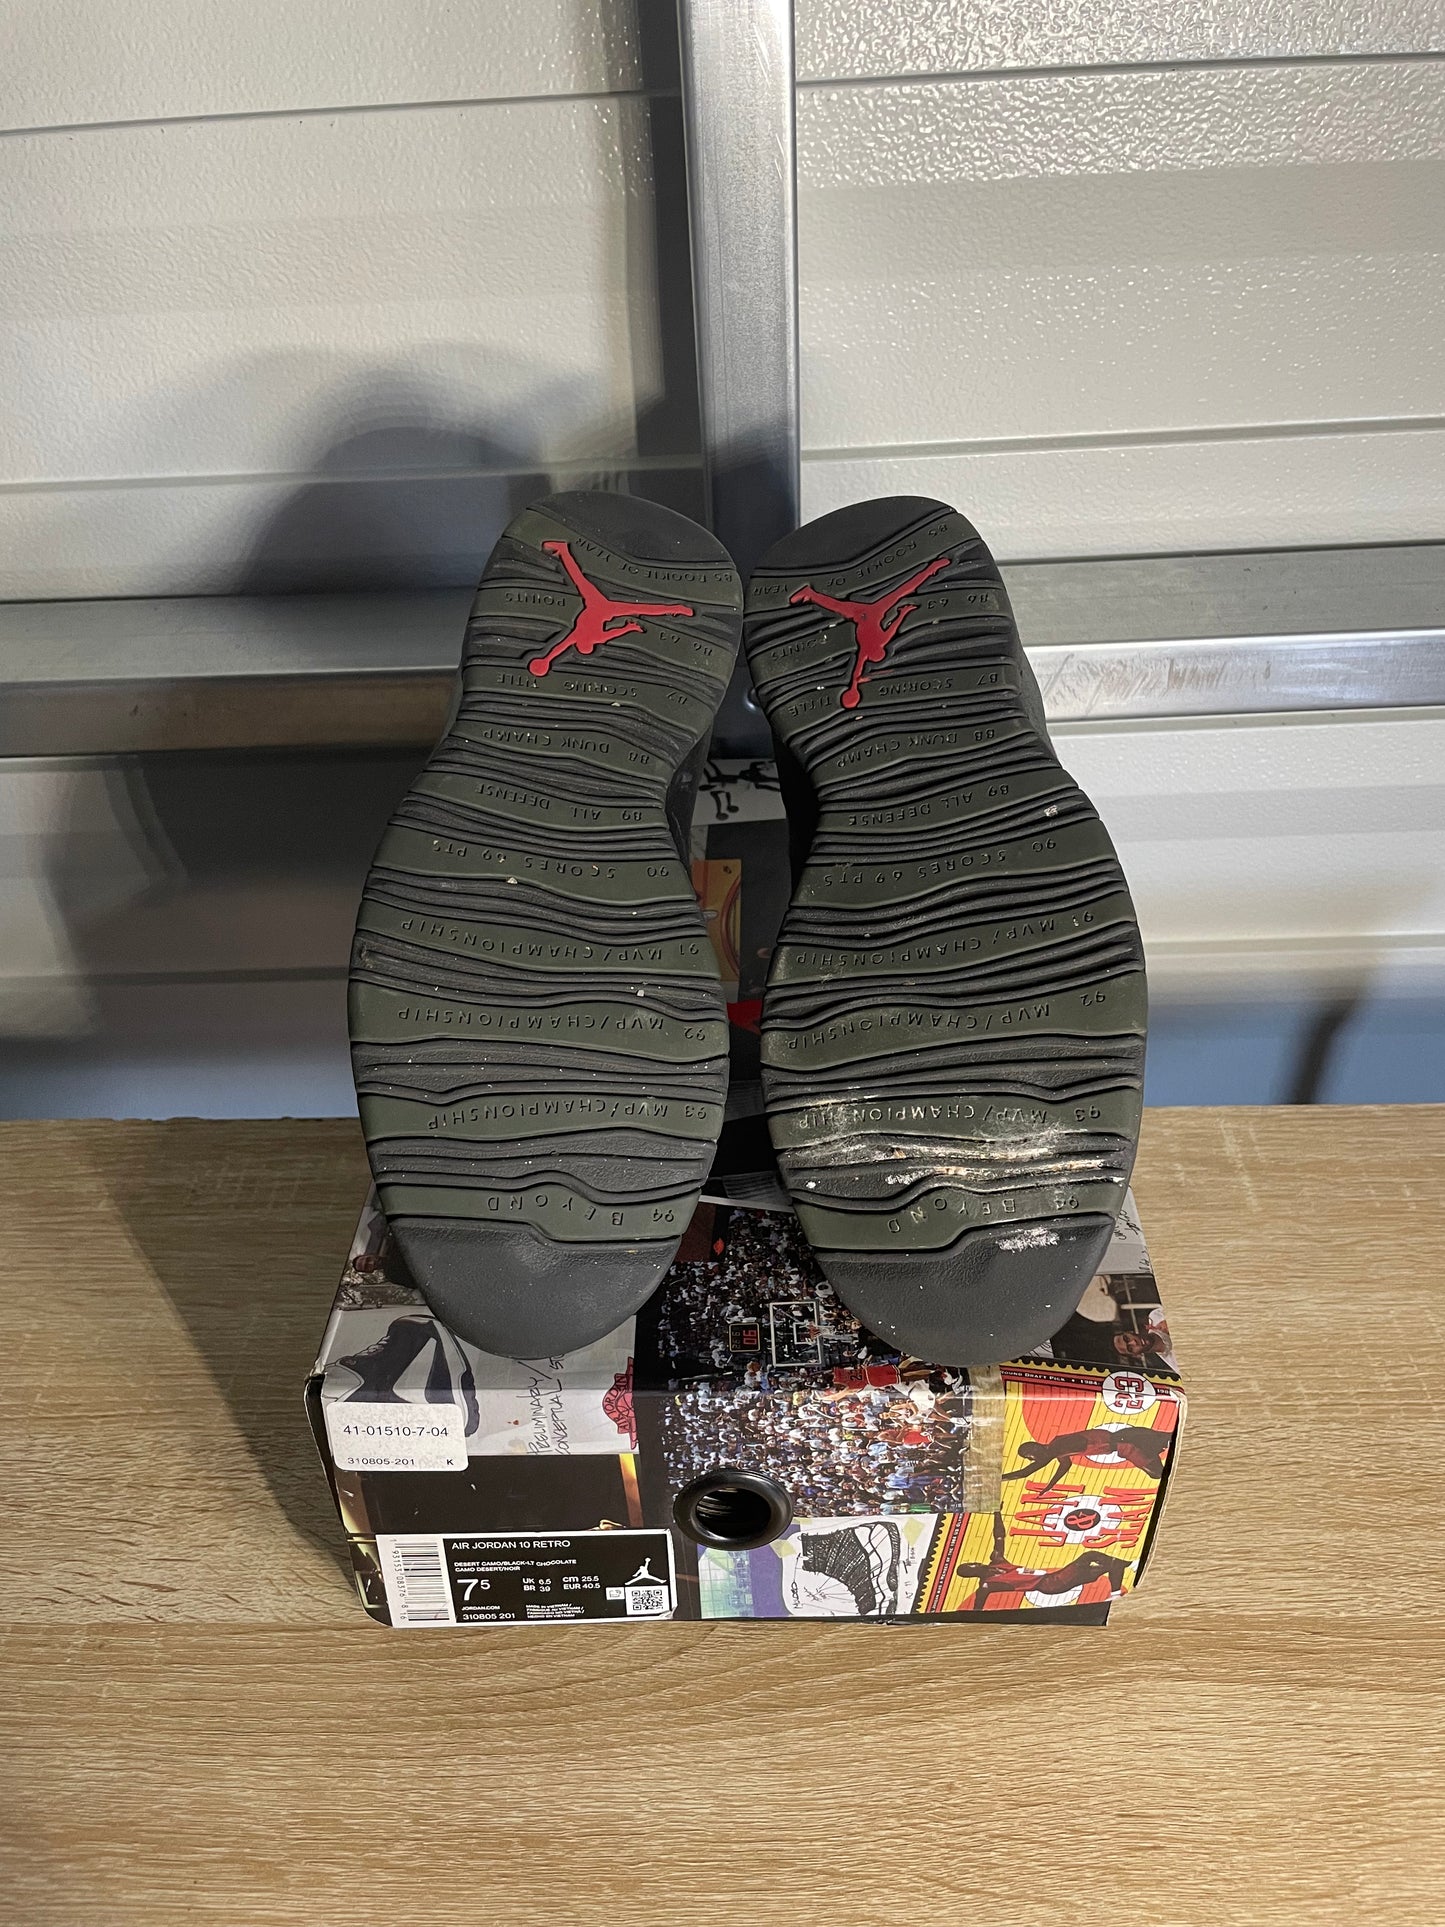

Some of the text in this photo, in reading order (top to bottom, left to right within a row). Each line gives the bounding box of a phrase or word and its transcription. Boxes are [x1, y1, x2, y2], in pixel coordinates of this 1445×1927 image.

[574, 536, 613, 563] YEAR
[854, 541, 917, 579] ROOKIE
[643, 569, 707, 584] ROOKIE
[752, 582, 788, 596] YEAR
[504, 592, 566, 608] POINTS
[768, 633, 828, 662] POINTS
[496, 671, 540, 690] TITLE
[562, 680, 638, 698] SCORING
[878, 676, 954, 696] SCORING
[787, 695, 832, 716] TITLE
[480, 727, 553, 747] CHAMP
[560, 735, 610, 755] DUNK
[906, 732, 958, 748] DUNK
[836, 738, 902, 769] CHAMP
[473, 781, 551, 811] DEFENSE
[940, 791, 974, 808] ALL
[568, 806, 602, 822] ALL
[846, 802, 932, 827] DEFENSE
[430, 838, 669, 880] 90 SCORES 69 PTS
[823, 838, 1058, 888] 90 SCORES 69 PTS
[678, 942, 700, 957] 91
[1079, 988, 1107, 1006] 92
[682, 1026, 707, 1042] 92
[684, 1104, 708, 1121] 93
[1073, 1104, 1102, 1122] 93
[486, 1193, 676, 1228] 94 BEYOND
[885, 1195, 1017, 1235] BEYOND
[603, 1373, 628, 1415] JORDAN
[1114, 1375, 1145, 1409] 23
[343, 1425, 449, 1437] 41-01510-7-04
[347, 1457, 454, 1466] 310805-201 K
[1009, 1481, 1085, 1548] JAM
[1082, 1486, 1159, 1549] SLAM
[452, 1540, 571, 1550] AIR JORDAN 10 RETRO
[536, 1559, 577, 1567] CHOCOLATE
